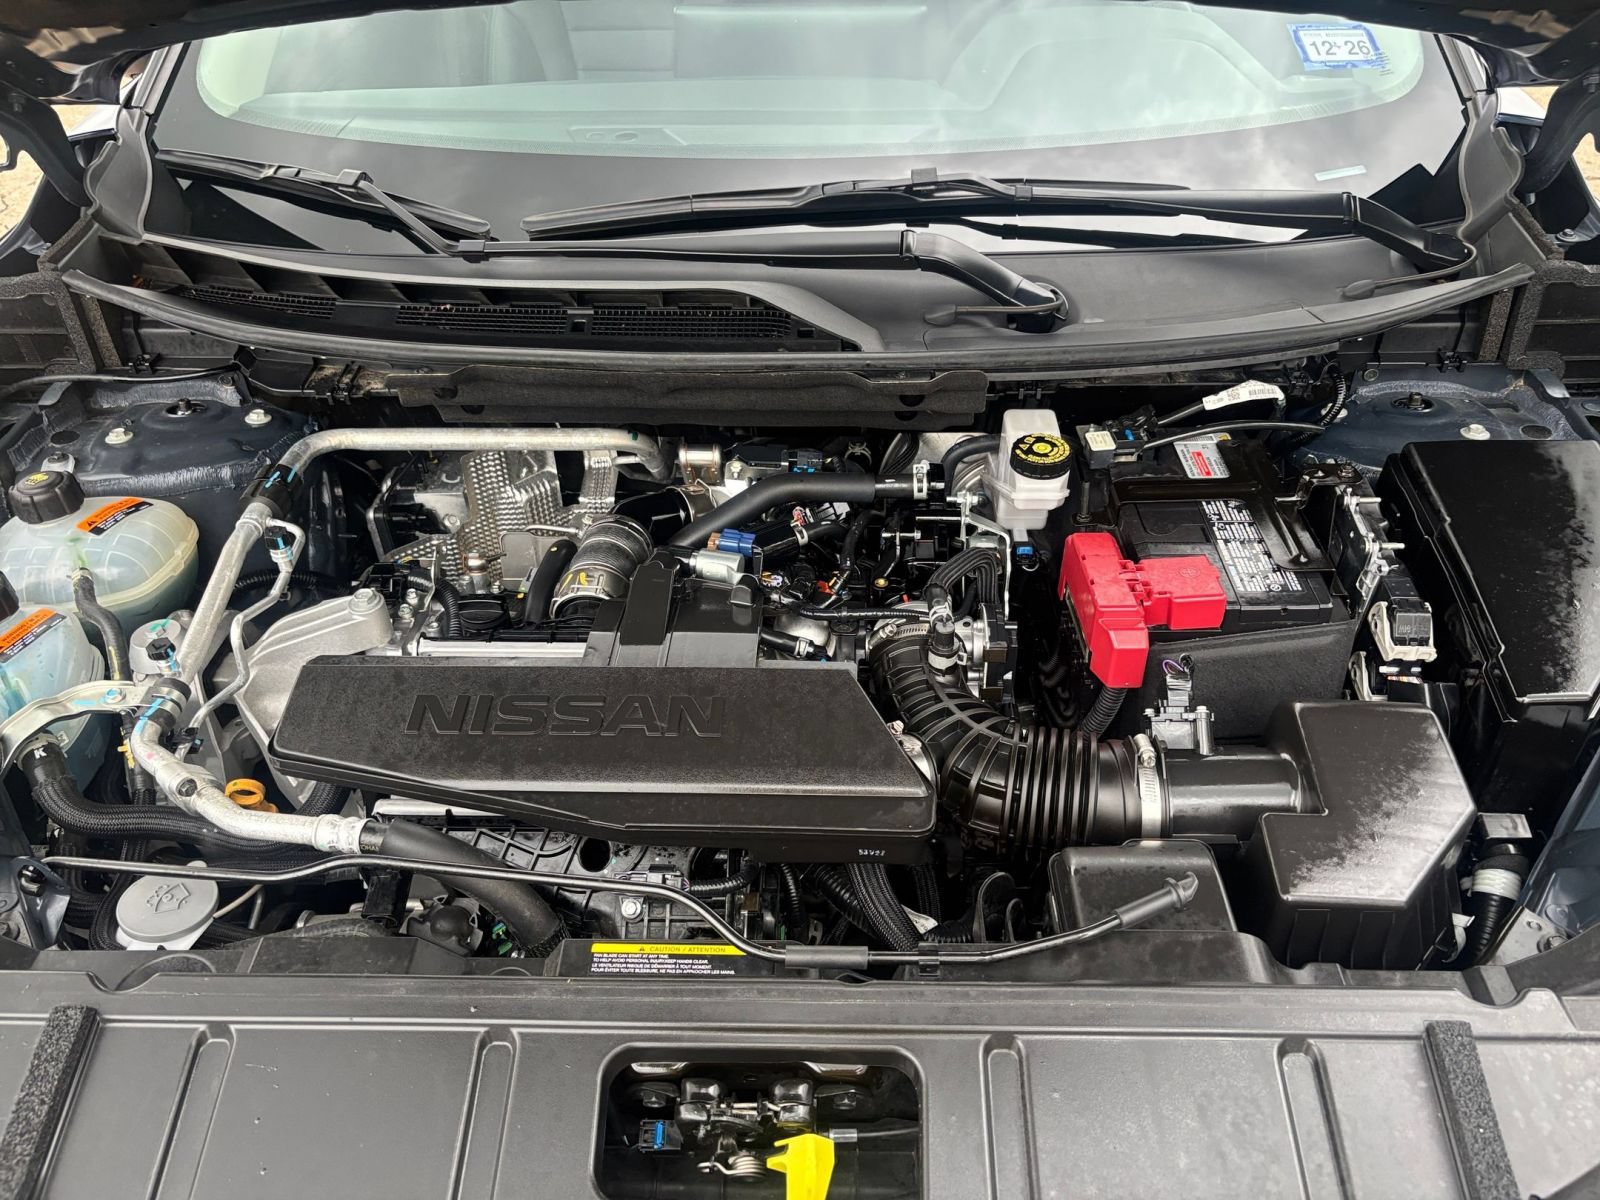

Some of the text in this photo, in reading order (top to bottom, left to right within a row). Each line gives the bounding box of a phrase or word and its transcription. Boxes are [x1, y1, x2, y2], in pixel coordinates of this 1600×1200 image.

[1309, 40, 1371, 56] 12 26
[405, 694, 724, 737] NISSAN
